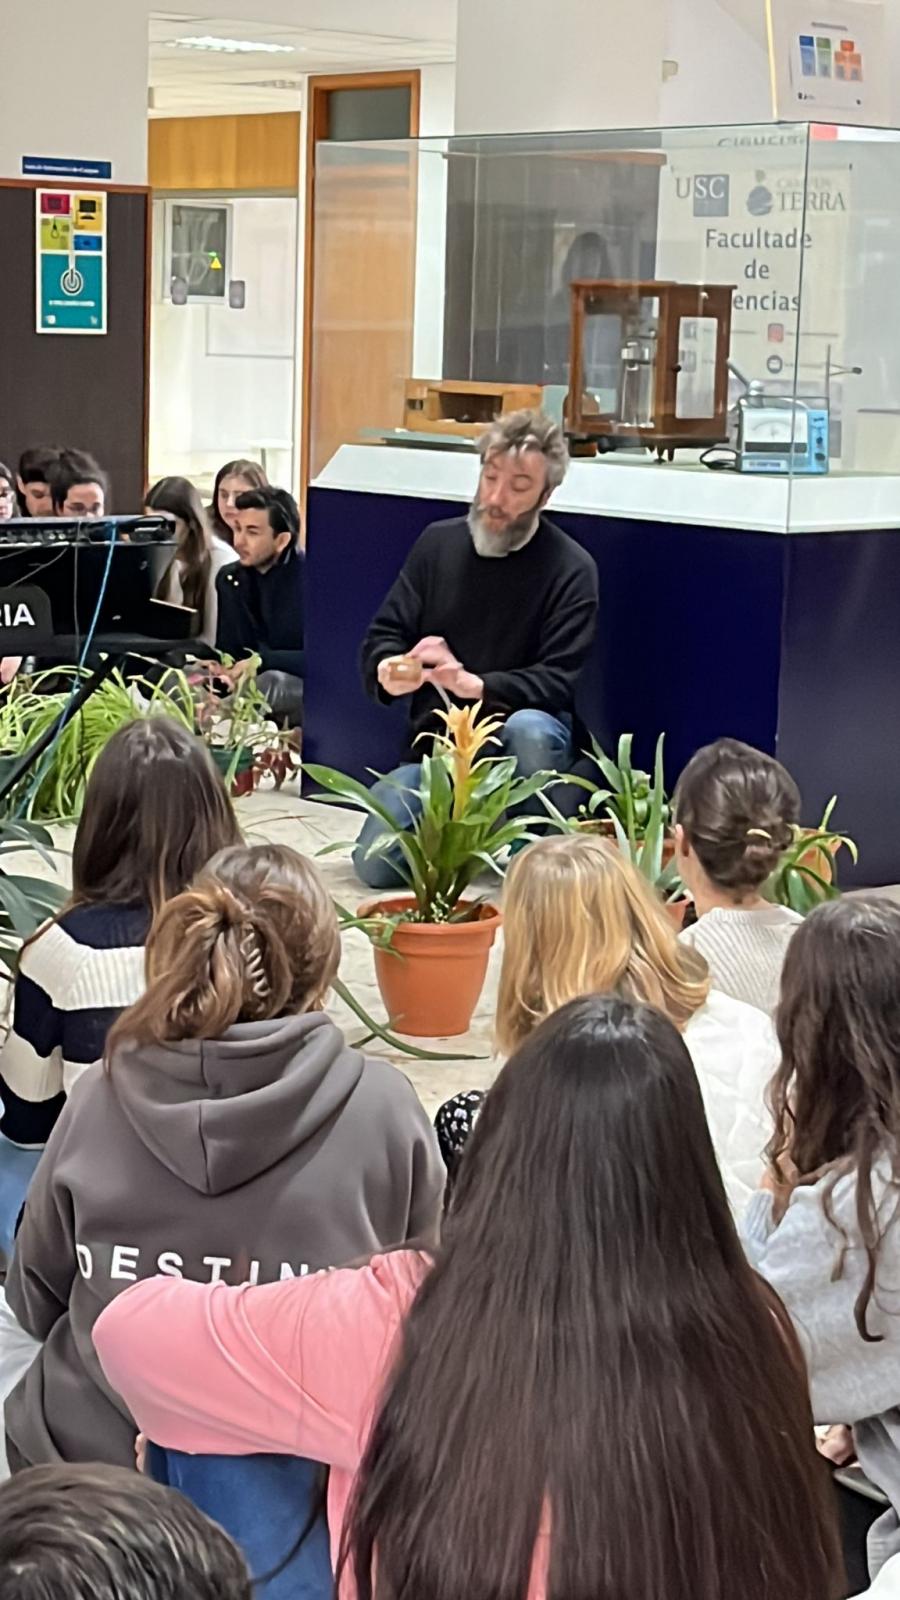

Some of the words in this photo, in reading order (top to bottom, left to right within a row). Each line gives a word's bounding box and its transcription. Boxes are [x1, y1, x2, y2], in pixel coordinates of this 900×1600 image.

[676, 176, 725, 199] USC
[775, 191, 847, 212] TERRA
[705, 227, 812, 249] Facultade
[744, 259, 770, 280] de
[733, 290, 800, 311] encias
[0, 603, 36, 627] IA
[76, 1244, 336, 1286] DESTIN
